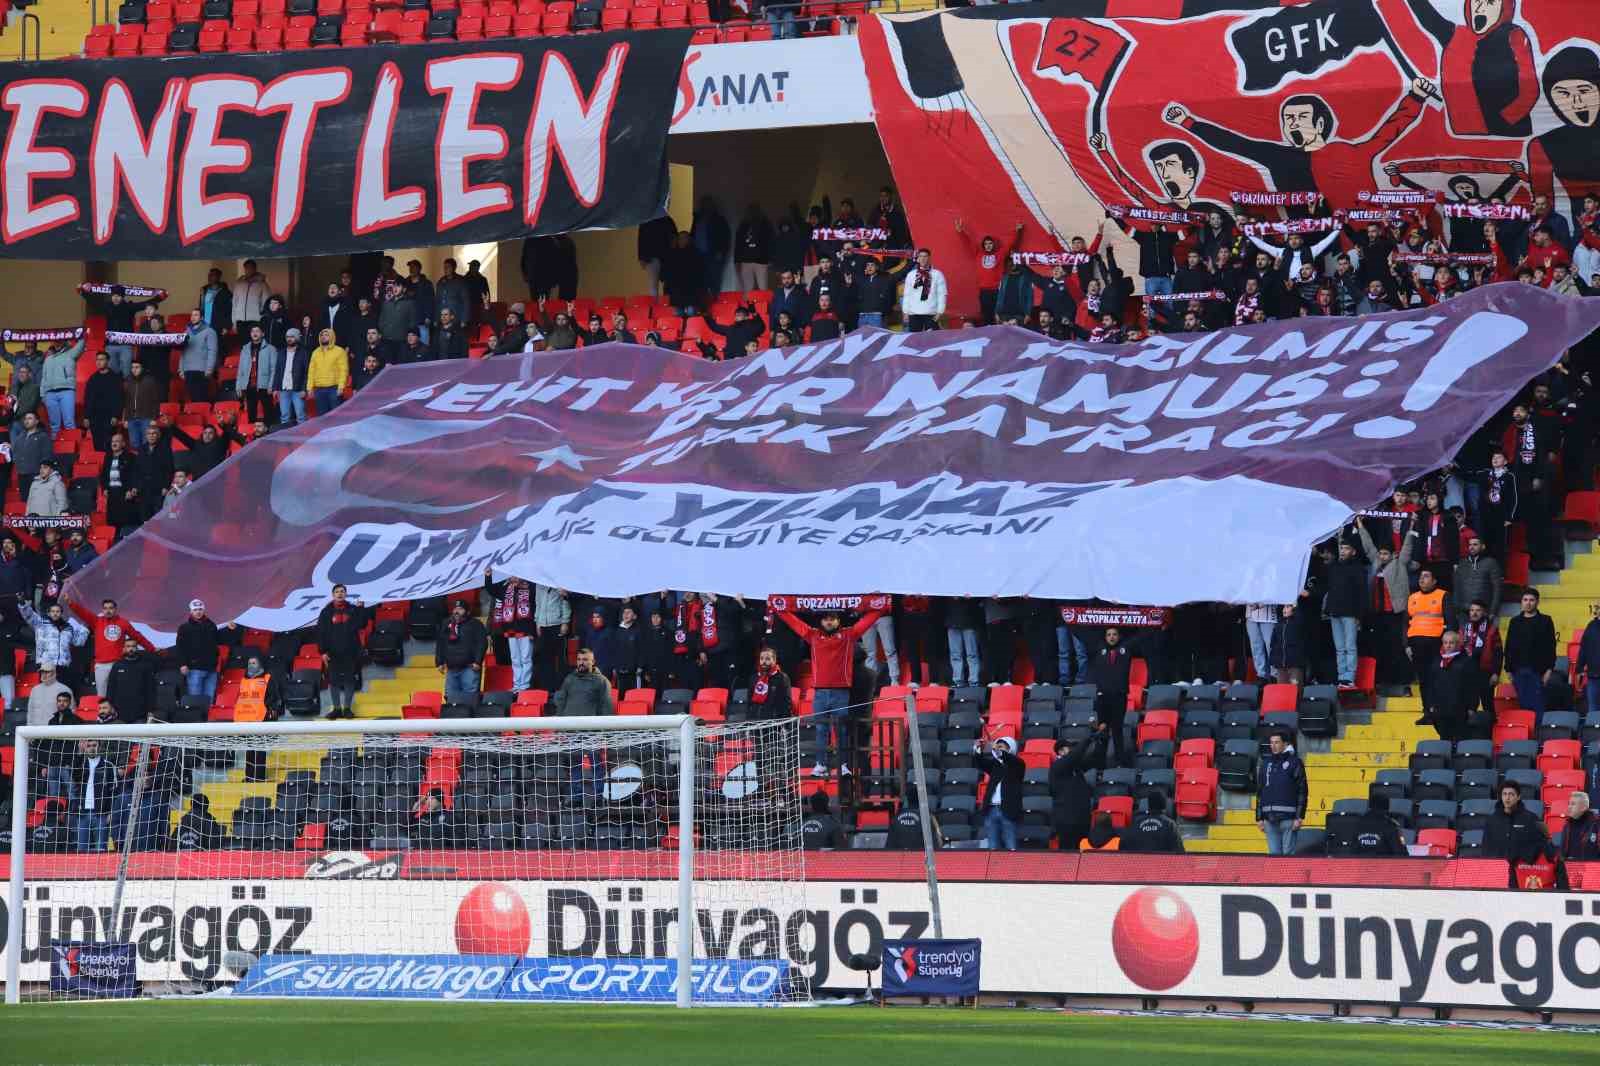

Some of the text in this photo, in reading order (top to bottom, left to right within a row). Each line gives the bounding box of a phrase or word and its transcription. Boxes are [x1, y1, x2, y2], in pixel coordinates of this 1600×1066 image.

[1056, 30, 1100, 62] 27
[1265, 14, 1339, 62] GFK
[671, 51, 789, 124] SANAT
[1, 42, 630, 246] ENETLEN
[796, 596, 862, 610] FORZANTEP
[1077, 614, 1147, 625] AKTOPRAK TAYFA
[0, 886, 313, 981] ünyagöz
[79, 952, 129, 968] trendyol
[919, 950, 975, 966] trendyol
